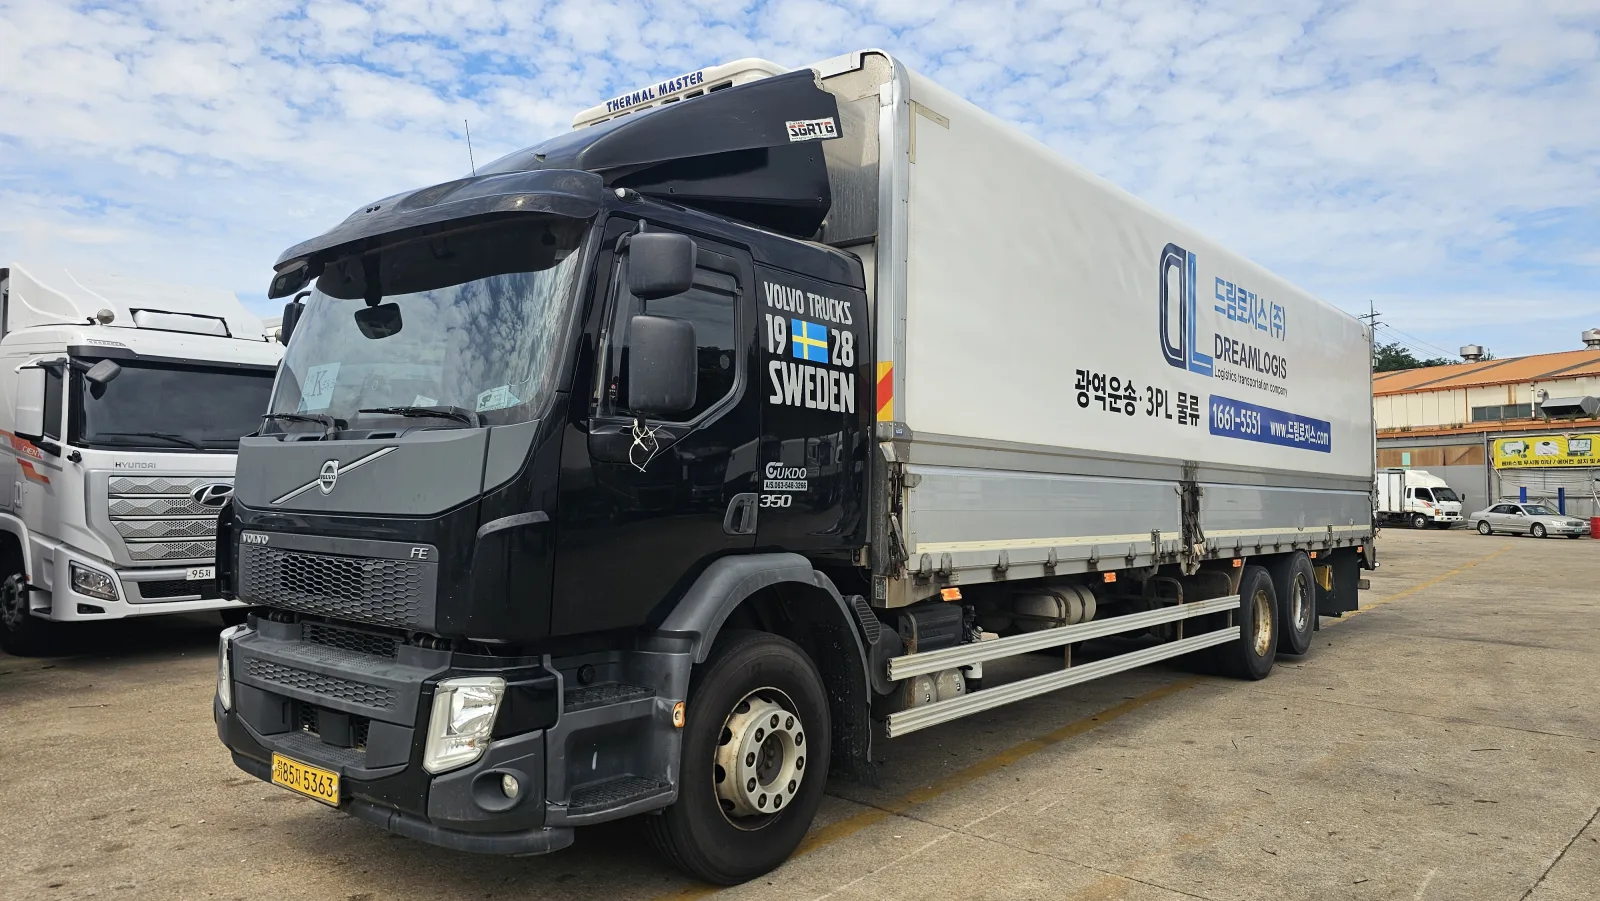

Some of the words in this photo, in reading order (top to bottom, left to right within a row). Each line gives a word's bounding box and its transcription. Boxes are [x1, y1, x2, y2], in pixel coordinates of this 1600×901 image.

[606, 87, 655, 113] THERMAL
[658, 71, 704, 96] MASTER
[763, 281, 805, 315] VOLVO
[807, 292, 853, 325] TRUCKS
[765, 313, 787, 355] 19
[831, 328, 855, 368] 28
[1214, 333, 1287, 380] DREAMLOGIS
[768, 360, 855, 414] SWEDEN
[1214, 365, 1237, 383] Logistics
[1237, 373, 1269, 392] transportation
[1269, 383, 1288, 397] company
[1146, 385, 1173, 420] 3PL
[1176, 391, 1200, 427] 물류
[1212, 403, 1261, 436] 1661-5551
[1270, 420, 1329, 446] www.드림로지스.com
[115, 461, 156, 469] HYUNDAI
[765, 461, 807, 479] GUKDO
[759, 494, 793, 508] 350
[241, 533, 269, 545] VOLVO
[410, 547, 429, 560] FE
[303, 770, 333, 798] 5363
